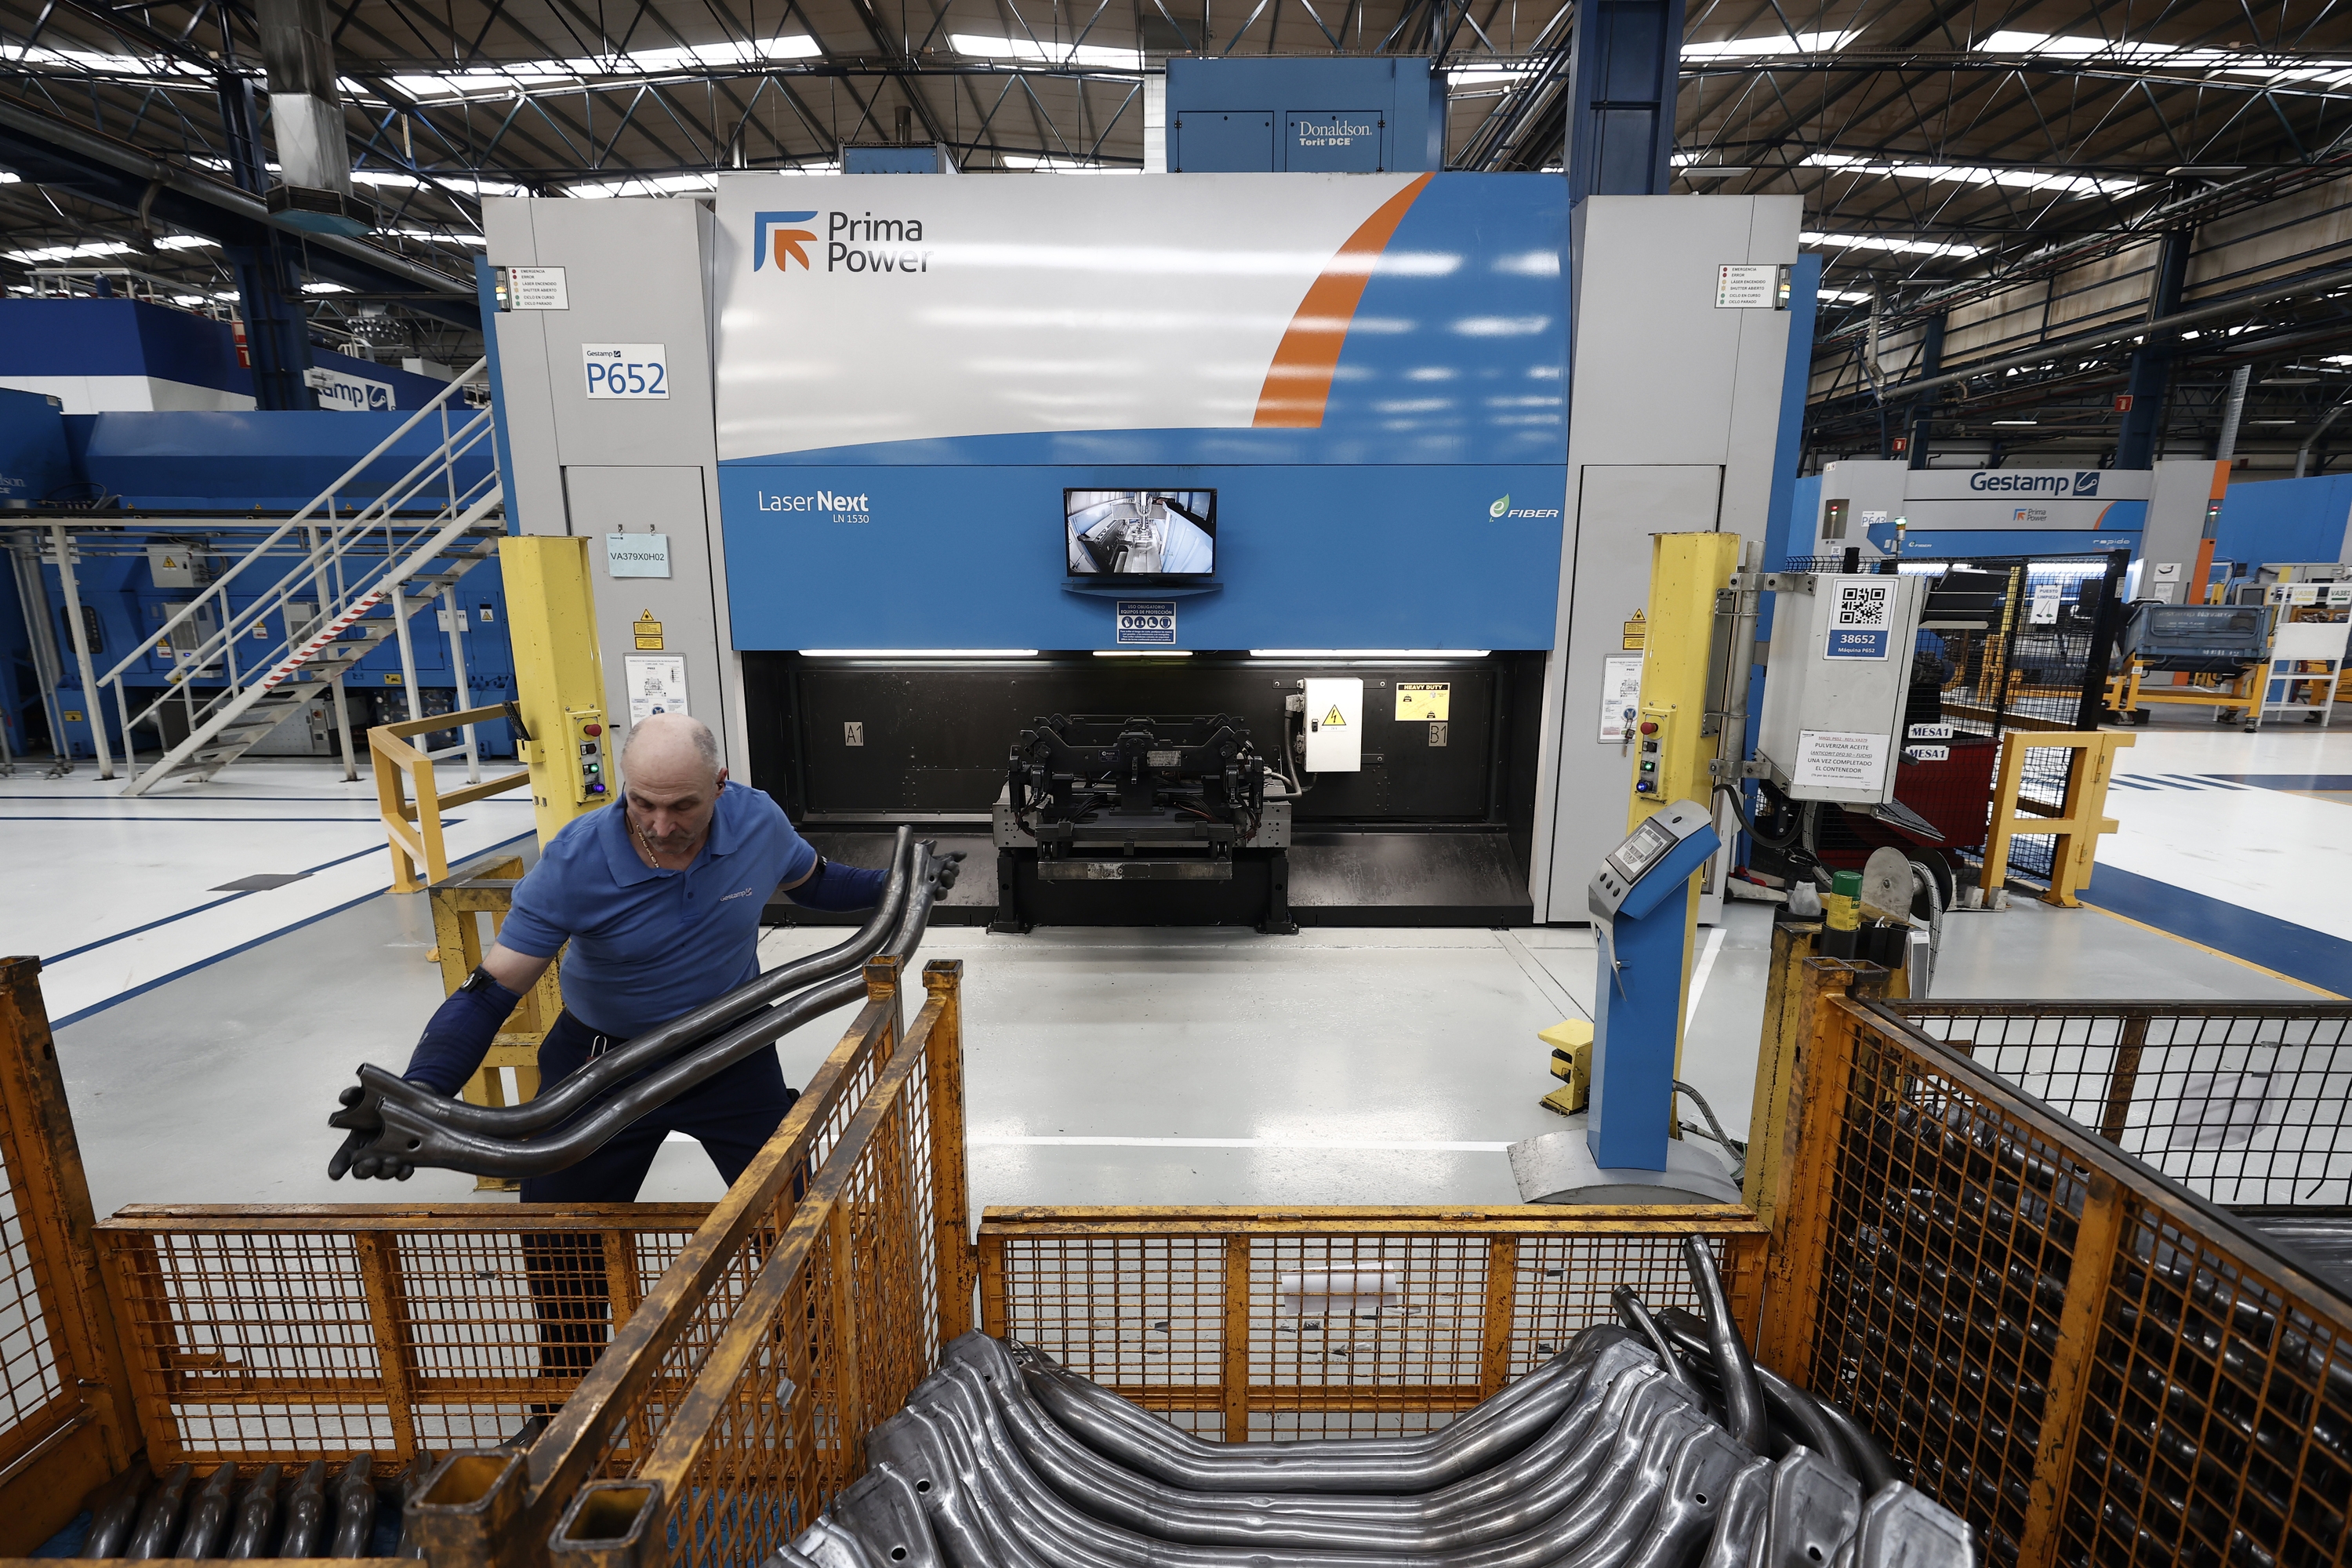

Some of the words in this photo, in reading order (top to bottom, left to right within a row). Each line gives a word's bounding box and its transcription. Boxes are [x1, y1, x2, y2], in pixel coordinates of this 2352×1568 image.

[829, 212, 923, 241] Prima
[828, 241, 934, 272] Power
[586, 362, 666, 394] P652
[1970, 472, 2069, 496] Gestamp
[758, 490, 815, 511] Laser
[817, 490, 869, 512] Next
[833, 514, 844, 523] LN
[847, 514, 869, 524] 1530
[1840, 634, 1875, 644] 38652
[847, 725, 862, 742] A1
[1430, 725, 1446, 743] B1
